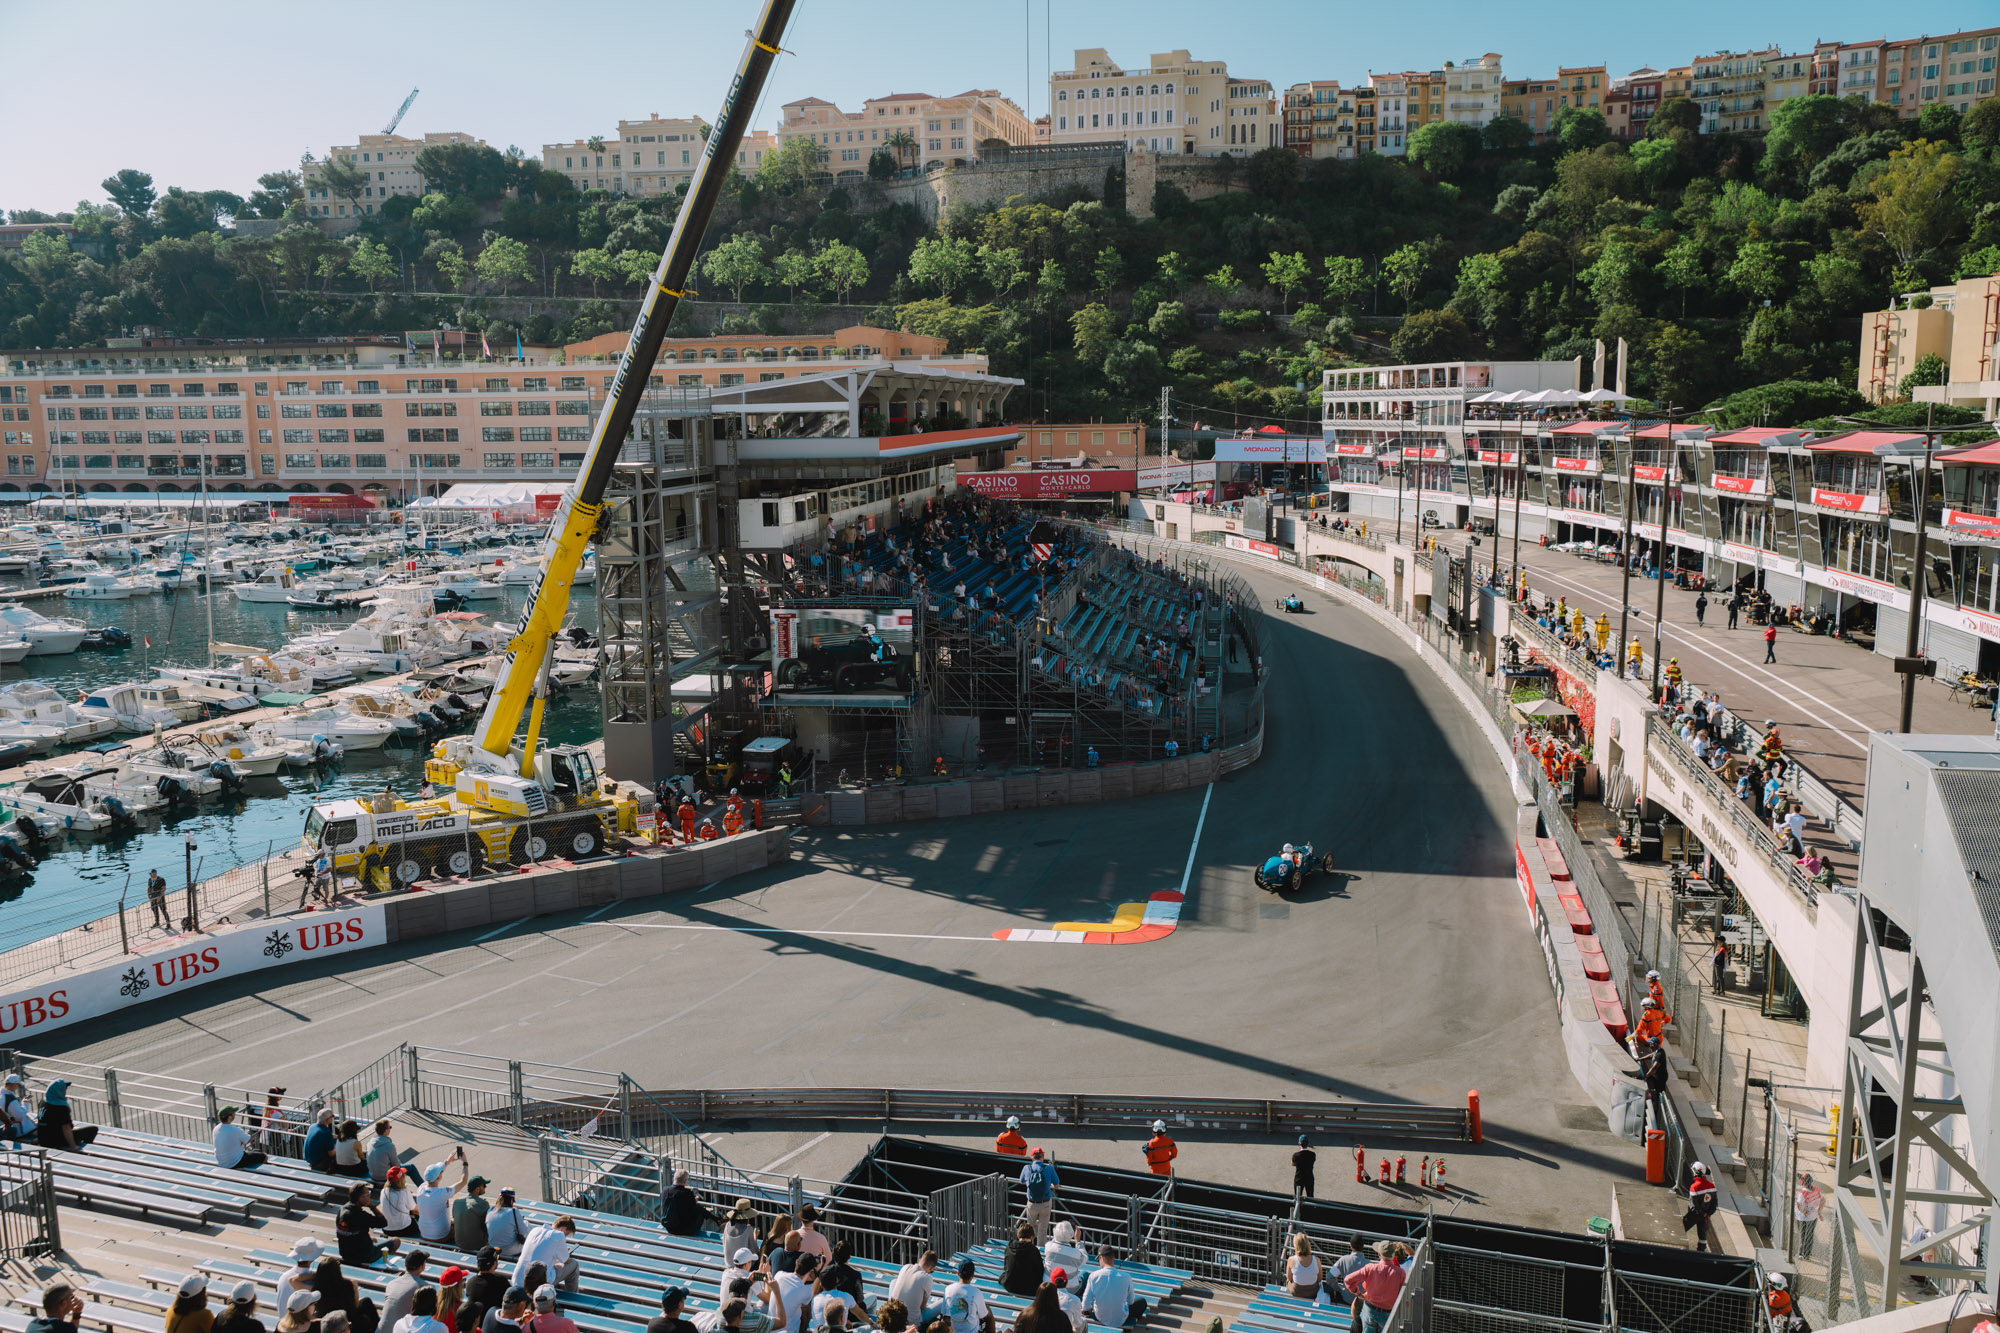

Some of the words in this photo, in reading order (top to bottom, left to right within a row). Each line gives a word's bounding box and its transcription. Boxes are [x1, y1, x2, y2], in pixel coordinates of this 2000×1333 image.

[966, 476, 1018, 488] CASINO
[1040, 474, 1091, 486] CASINO
[1139, 472, 1172, 481] MONAO
[297, 917, 364, 951] UBS
[152, 946, 220, 987] UBS
[0, 990, 70, 1034] UBS
